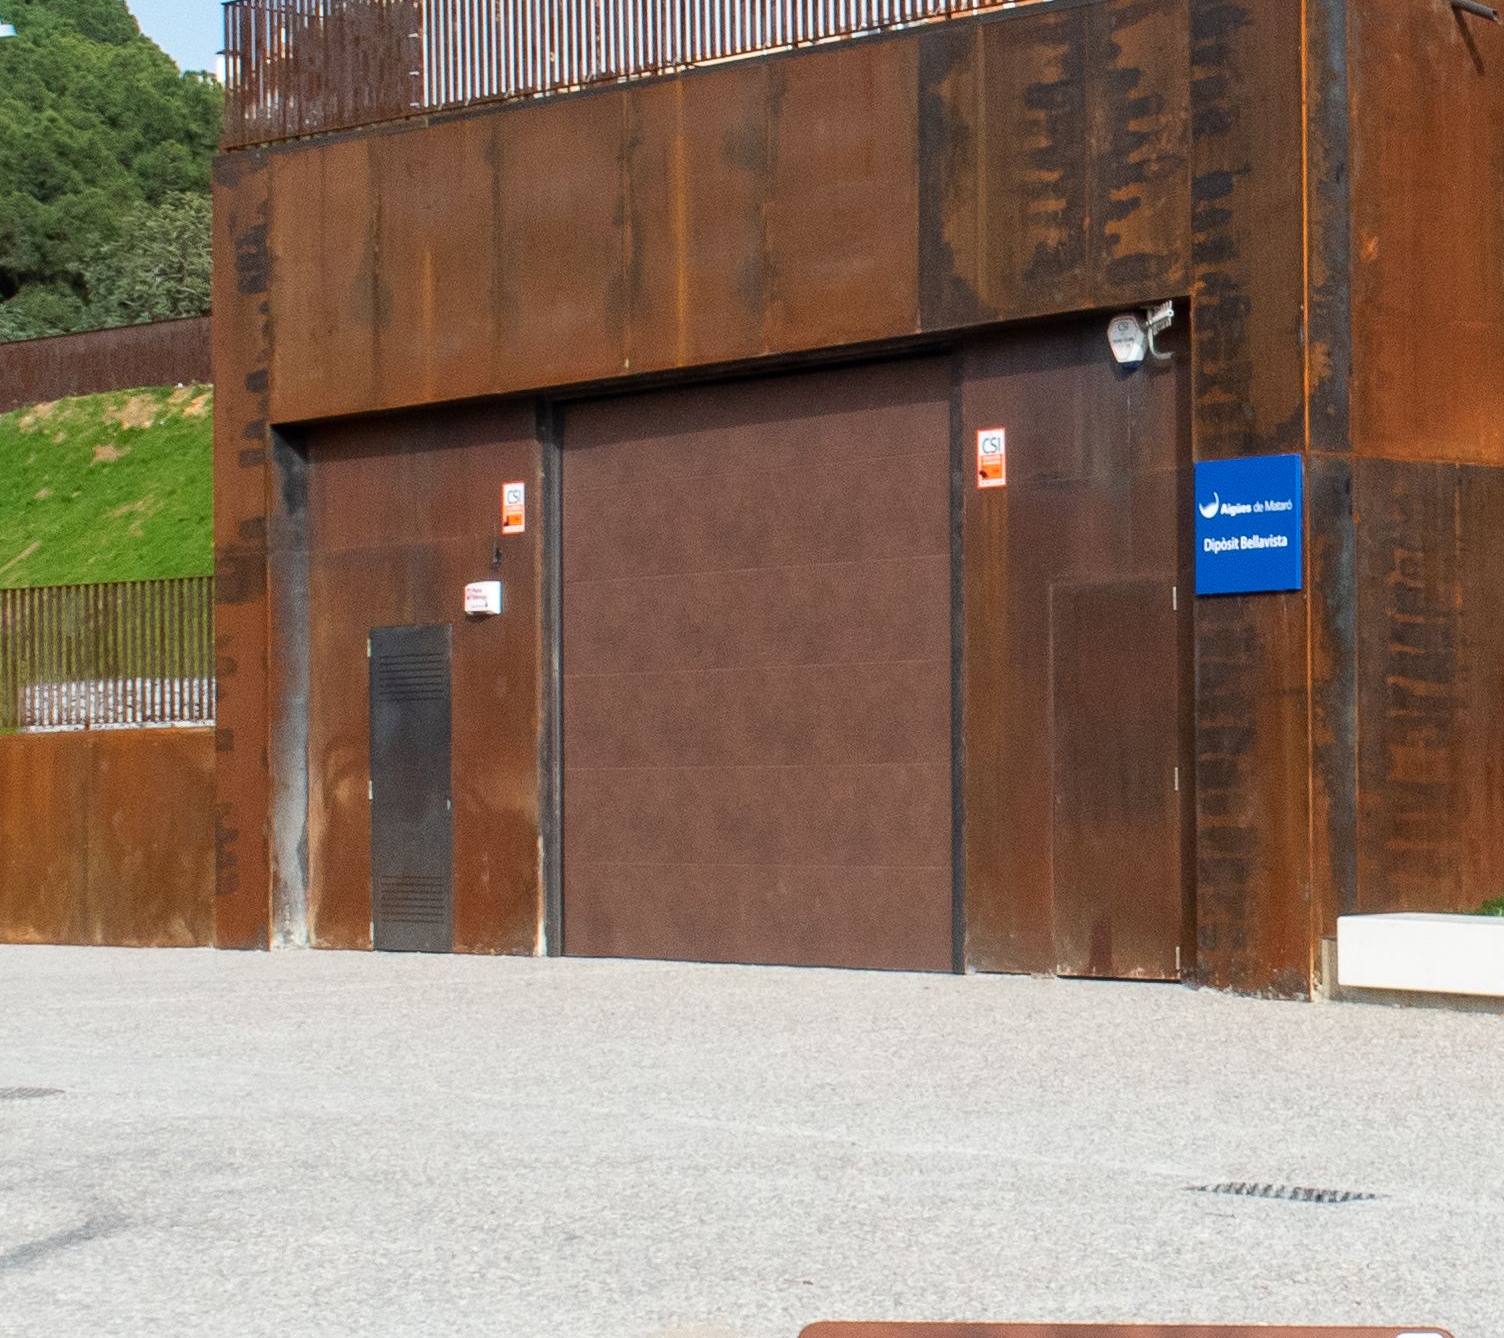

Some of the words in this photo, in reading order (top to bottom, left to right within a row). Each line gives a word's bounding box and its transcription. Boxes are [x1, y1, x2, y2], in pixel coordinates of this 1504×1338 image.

[982, 437, 1001, 454] CSI
[1220, 503, 1252, 517] Aigües
[1253, 501, 1264, 513] de
[1264, 499, 1293, 512] Mataró
[1204, 536, 1239, 555] Dipòsit
[1240, 534, 1288, 550] Bellavista
